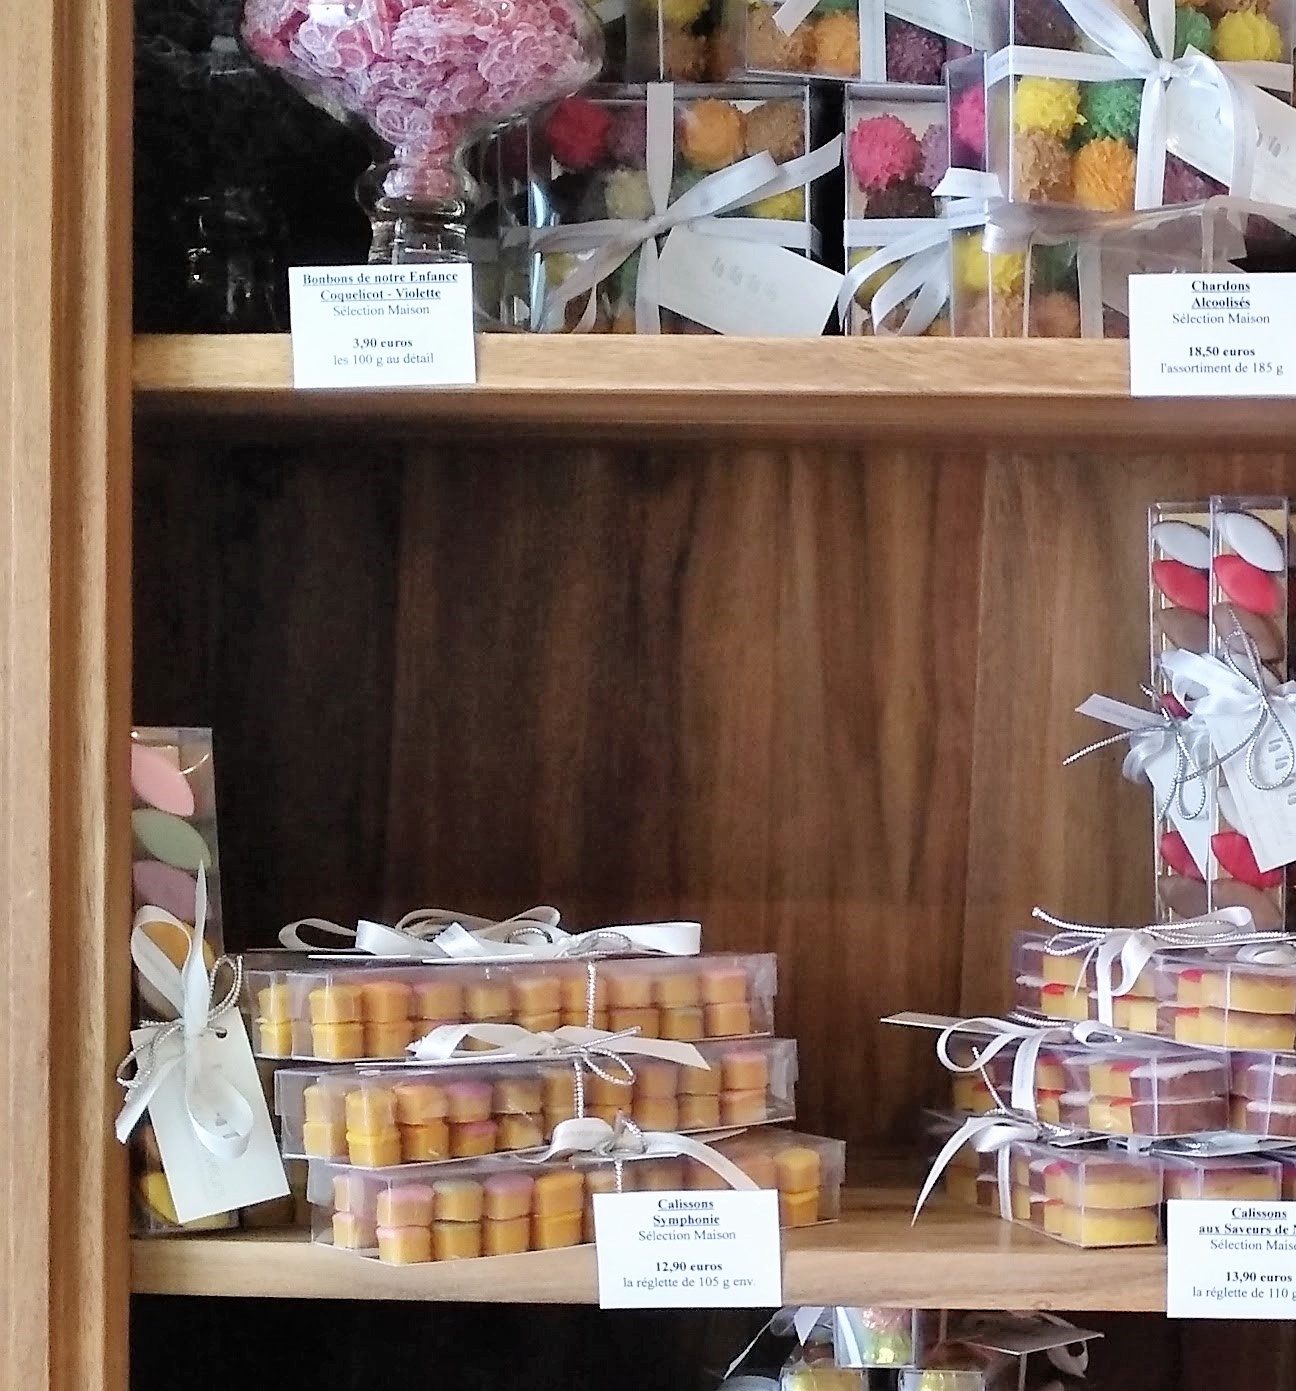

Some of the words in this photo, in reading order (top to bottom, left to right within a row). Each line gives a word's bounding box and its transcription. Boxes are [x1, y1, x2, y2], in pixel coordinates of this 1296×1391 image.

[303, 274, 353, 285] Bonbons
[358, 274, 371, 284] de
[375, 273, 405, 283] notre
[410, 272, 458, 282] Enfance
[1192, 280, 1251, 292] Chardons
[321, 289, 383, 301] Coquelicot
[396, 288, 441, 299] Violette
[1192, 297, 1251, 308] Alcoolisés
[333, 305, 384, 316] Sélection
[388, 305, 430, 315] Maison
[1172, 313, 1224, 324] Sélection
[1229, 313, 1270, 324] Maison
[353, 338, 377, 349] 3,90
[381, 339, 413, 348] euros
[1189, 346, 1219, 357] 18,50
[1223, 348, 1255, 356] euros
[334, 354, 348, 365] les
[353, 354, 372, 364] 100
[376, 356, 383, 367] g
[387, 356, 400, 364] au
[403, 353, 434, 364] détail
[1161, 363, 1231, 374] l'assortiment
[1235, 363, 1248, 373] de
[1253, 363, 1272, 373] 185
[1277, 366, 1283, 376] g
[658, 1199, 714, 1209] Calissons
[1232, 1207, 1287, 1219] Calissons
[654, 1214, 720, 1226] Symphonie
[638, 1230, 690, 1241] Sélection
[694, 1229, 736, 1240] Maison
[1224, 1224, 1271, 1234] Saveurs
[1275, 1225, 1288, 1235] de
[1211, 1240, 1262, 1250] Sélection
[656, 1262, 686, 1272] 12,90
[690, 1263, 722, 1271] euros
[1226, 1271, 1256, 1282] 13,90
[1260, 1274, 1292, 1282] euros
[623, 1277, 633, 1287] la
[637, 1277, 678, 1289] réglette
[682, 1277, 695, 1287] de
[699, 1277, 718, 1287] 105
[723, 1279, 730, 1289] g
[1193, 1286, 1202, 1297] la
[1206, 1286, 1247, 1299] réglette
[1251, 1287, 1264, 1298] de
[1269, 1288, 1288, 1298] 110
